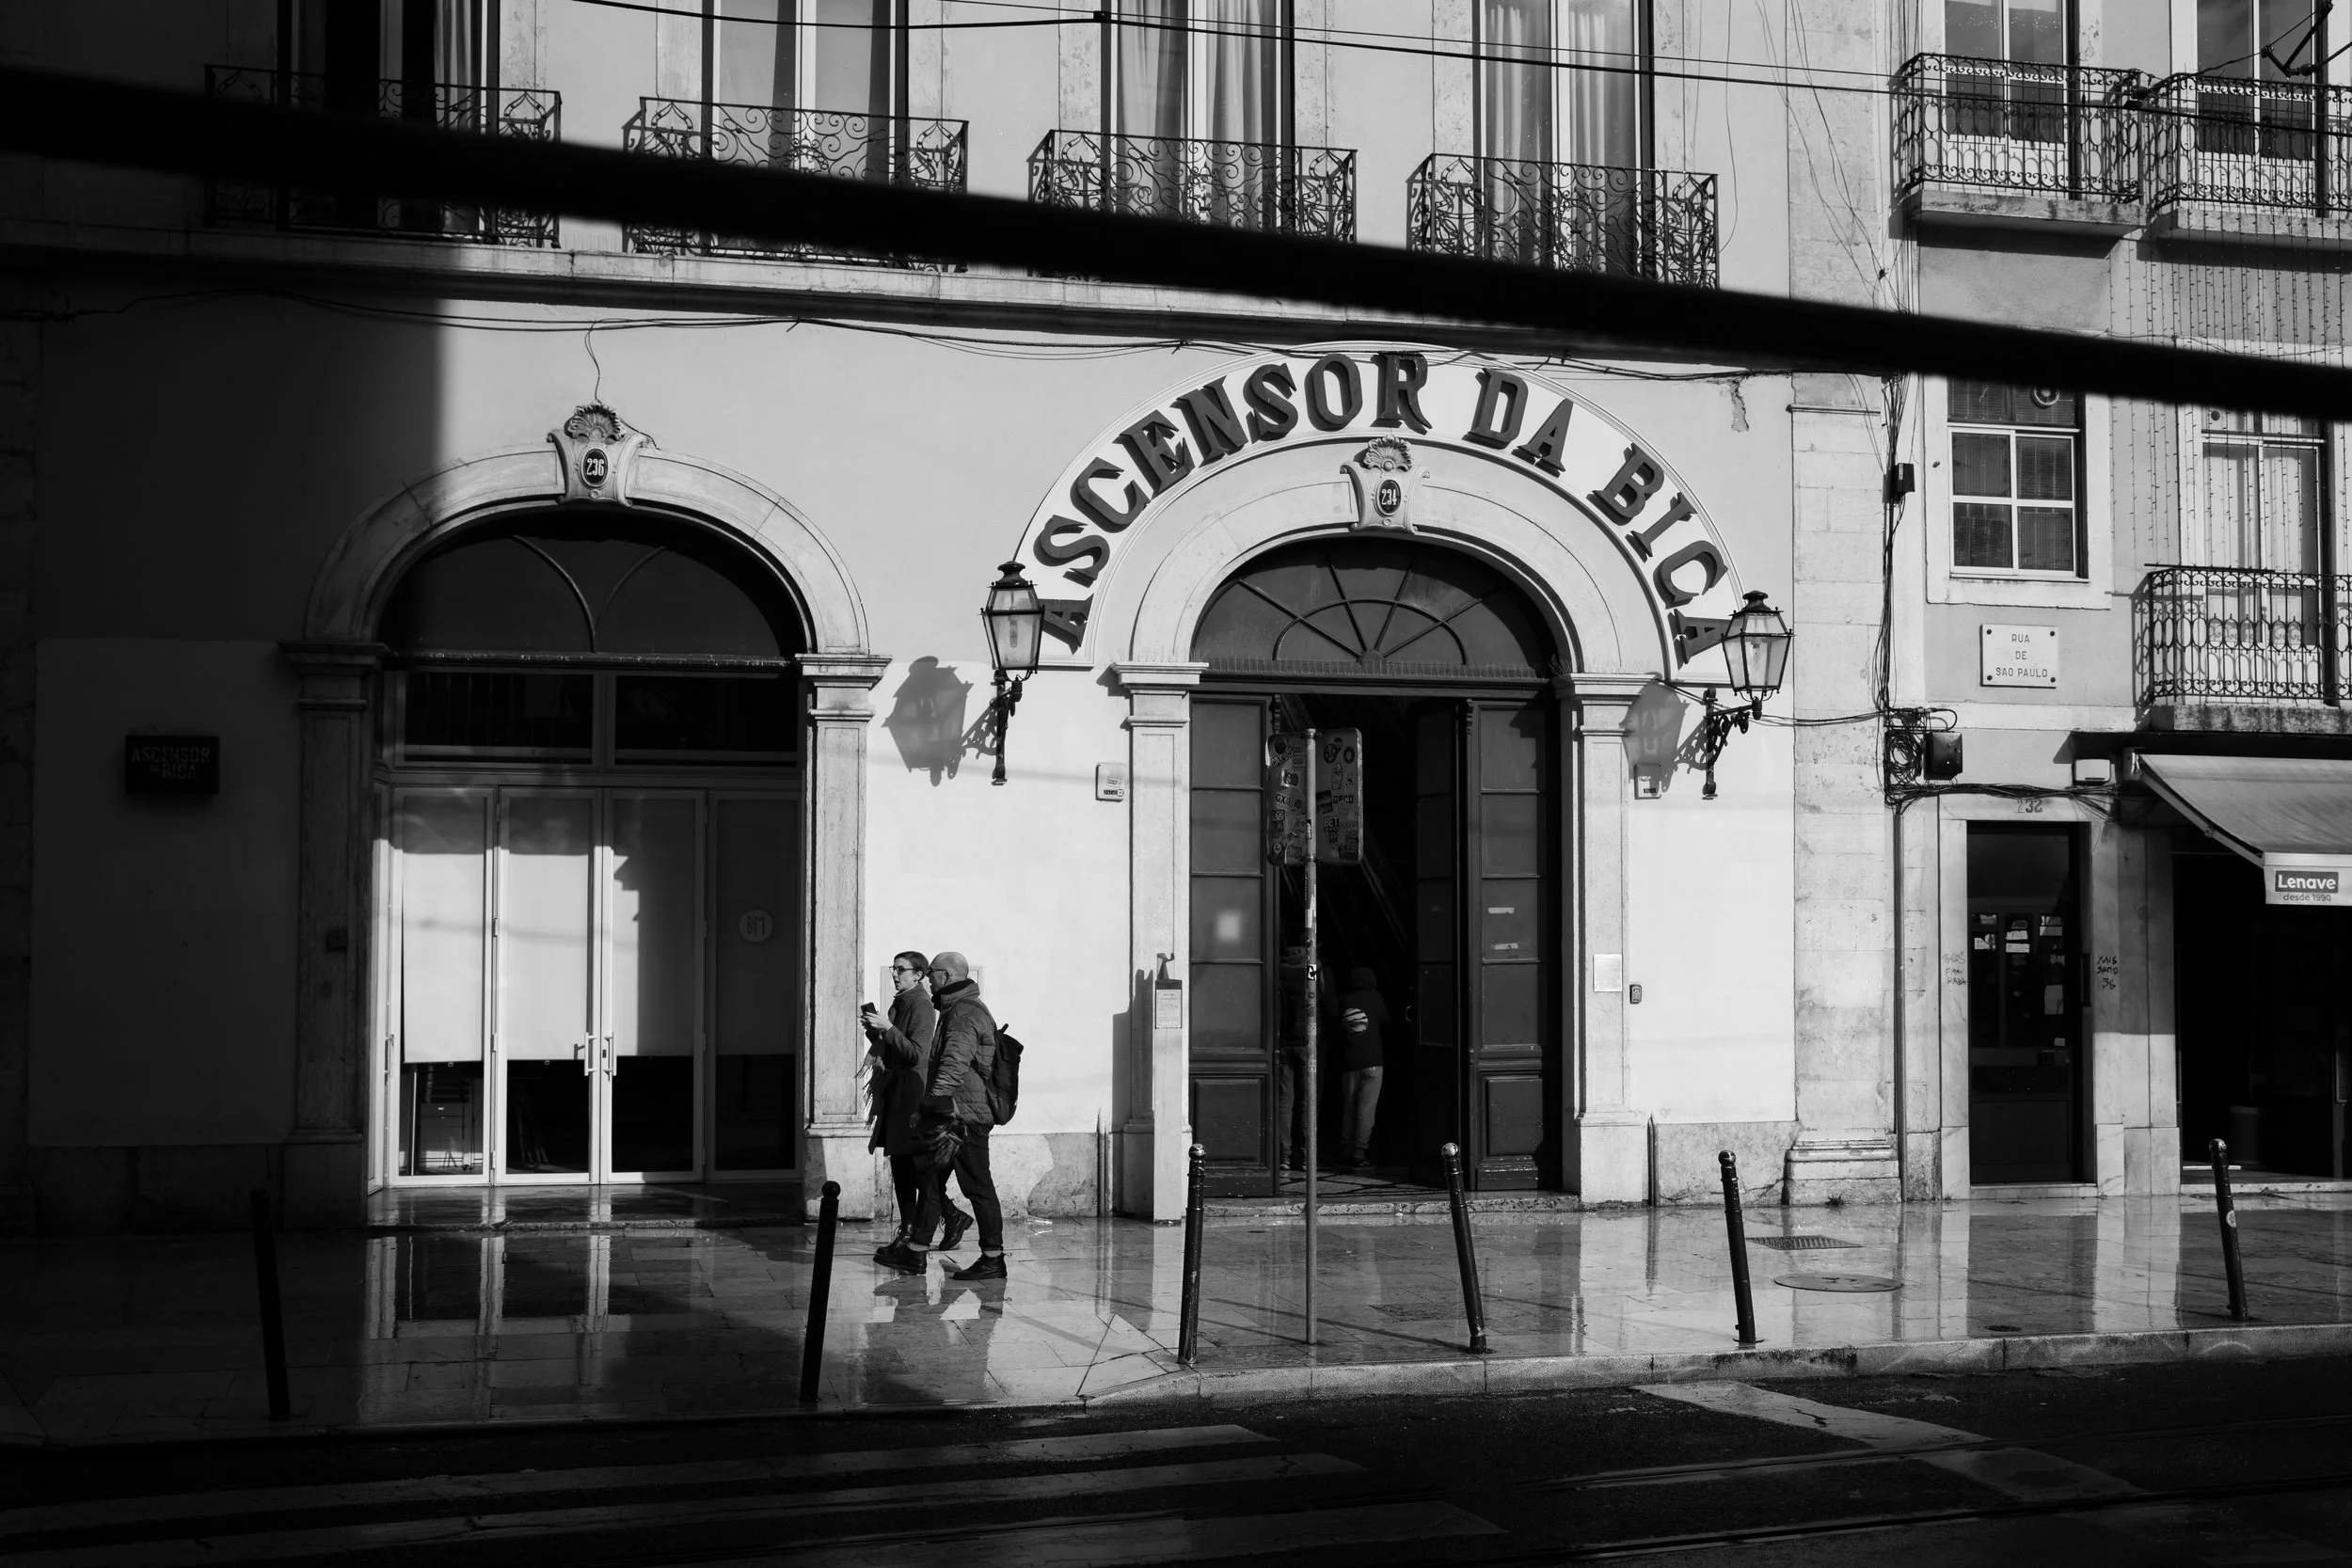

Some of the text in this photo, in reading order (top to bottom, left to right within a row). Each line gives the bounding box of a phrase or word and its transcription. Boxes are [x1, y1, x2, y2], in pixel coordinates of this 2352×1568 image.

[586, 457, 605, 477] 236
[1381, 488, 1398, 506] 234
[1033, 351, 1732, 667] ASCENSOR DA BICA
[2011, 633, 2030, 643] RUA
[2015, 651, 2027, 660] DE
[2017, 667, 2048, 678] PAULO
[131, 746, 212, 764] ASCENSOR
[2278, 874, 2337, 890] Lenave
[2283, 893, 2332, 902] desde 1990
